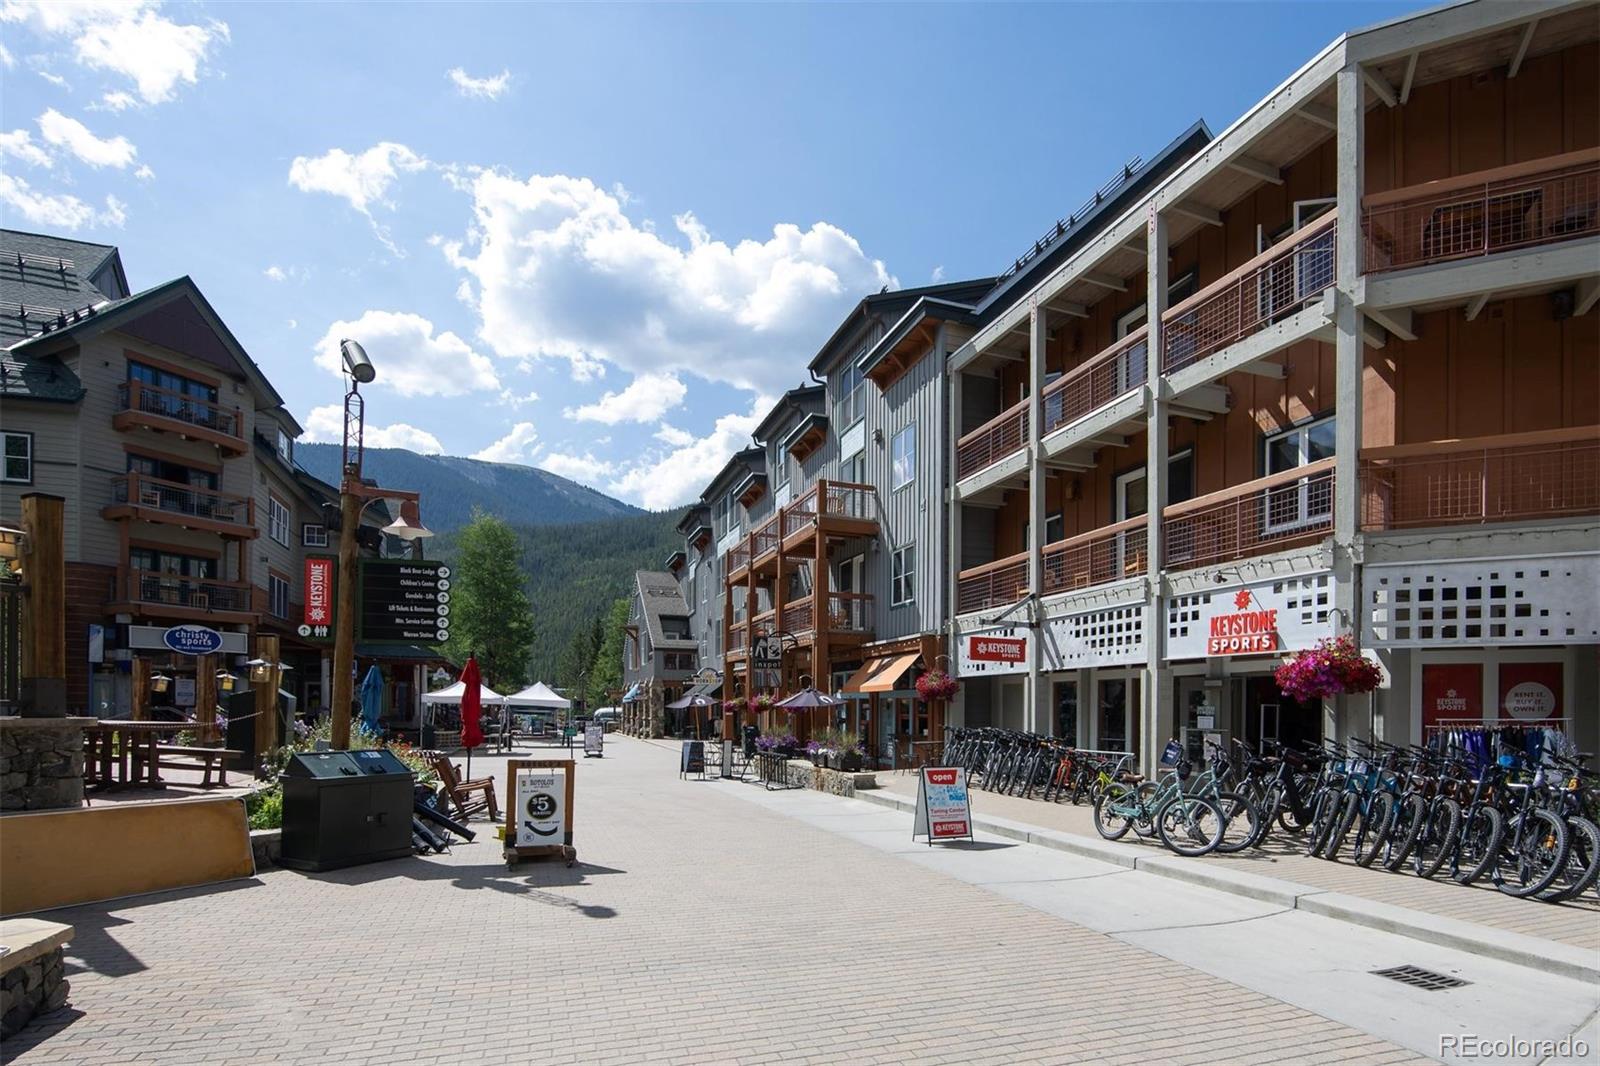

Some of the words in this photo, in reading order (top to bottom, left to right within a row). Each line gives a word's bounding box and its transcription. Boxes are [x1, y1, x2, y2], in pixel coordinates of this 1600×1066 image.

[311, 564, 323, 606] KEYSTONE
[1210, 609, 1278, 637] KEYSTONE
[175, 630, 210, 640] christy
[181, 638, 212, 646] sports
[1211, 635, 1270, 652] SPORTS
[988, 643, 1021, 654] KEYSTONE
[932, 774, 953, 782] open
[942, 823, 964, 831] KEYSTONE
